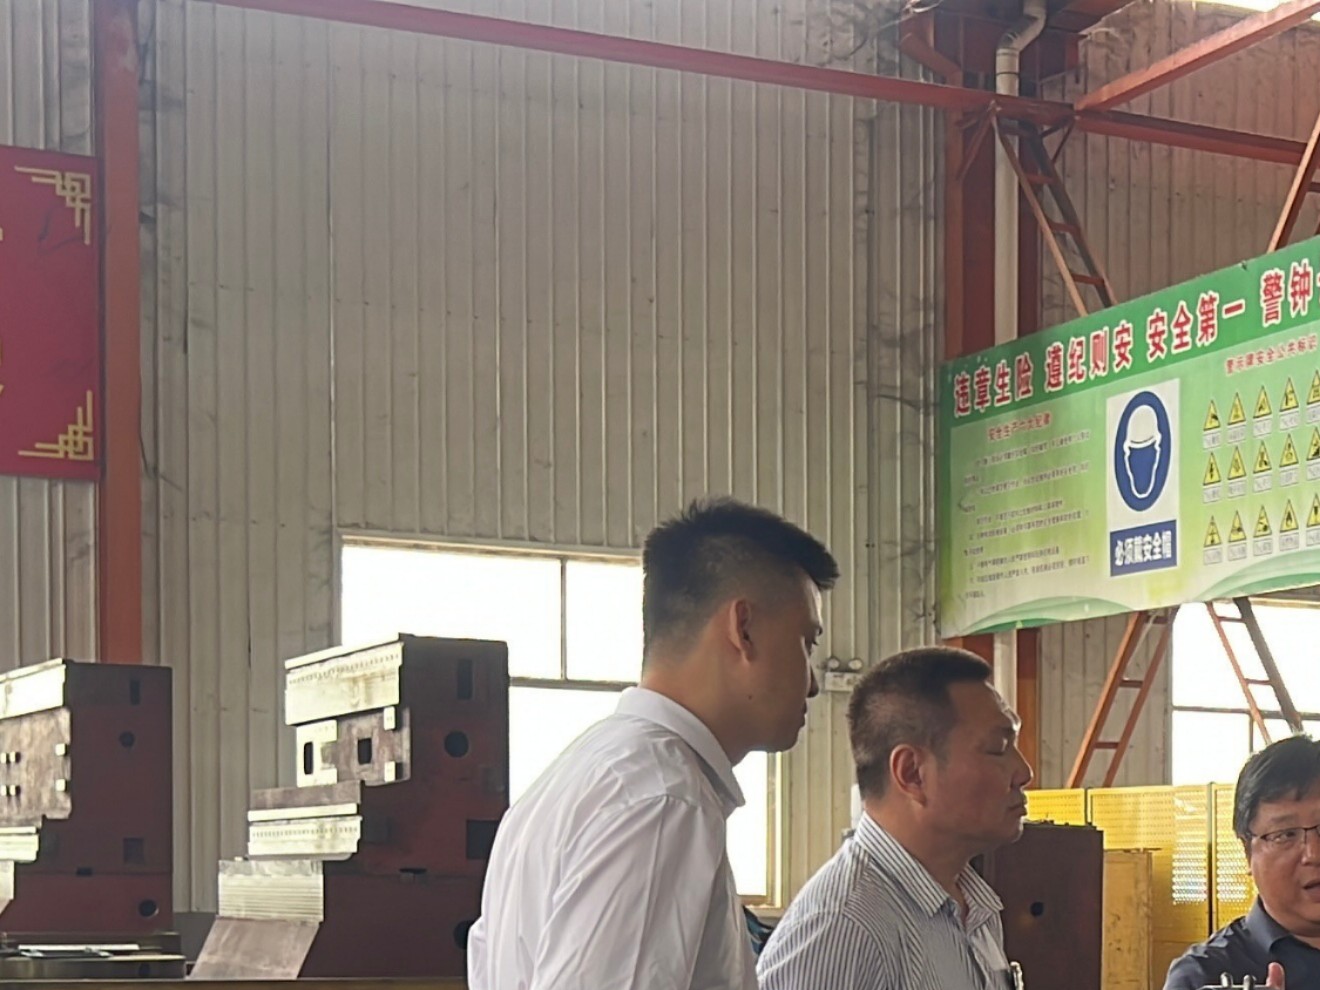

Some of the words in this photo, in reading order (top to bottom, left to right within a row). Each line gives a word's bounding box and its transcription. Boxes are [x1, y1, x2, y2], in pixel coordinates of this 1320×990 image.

[955, 354, 1032, 416] 违章生险
[1045, 321, 1132, 391] 遵纪则安
[1147, 292, 1245, 361] 安全第一
